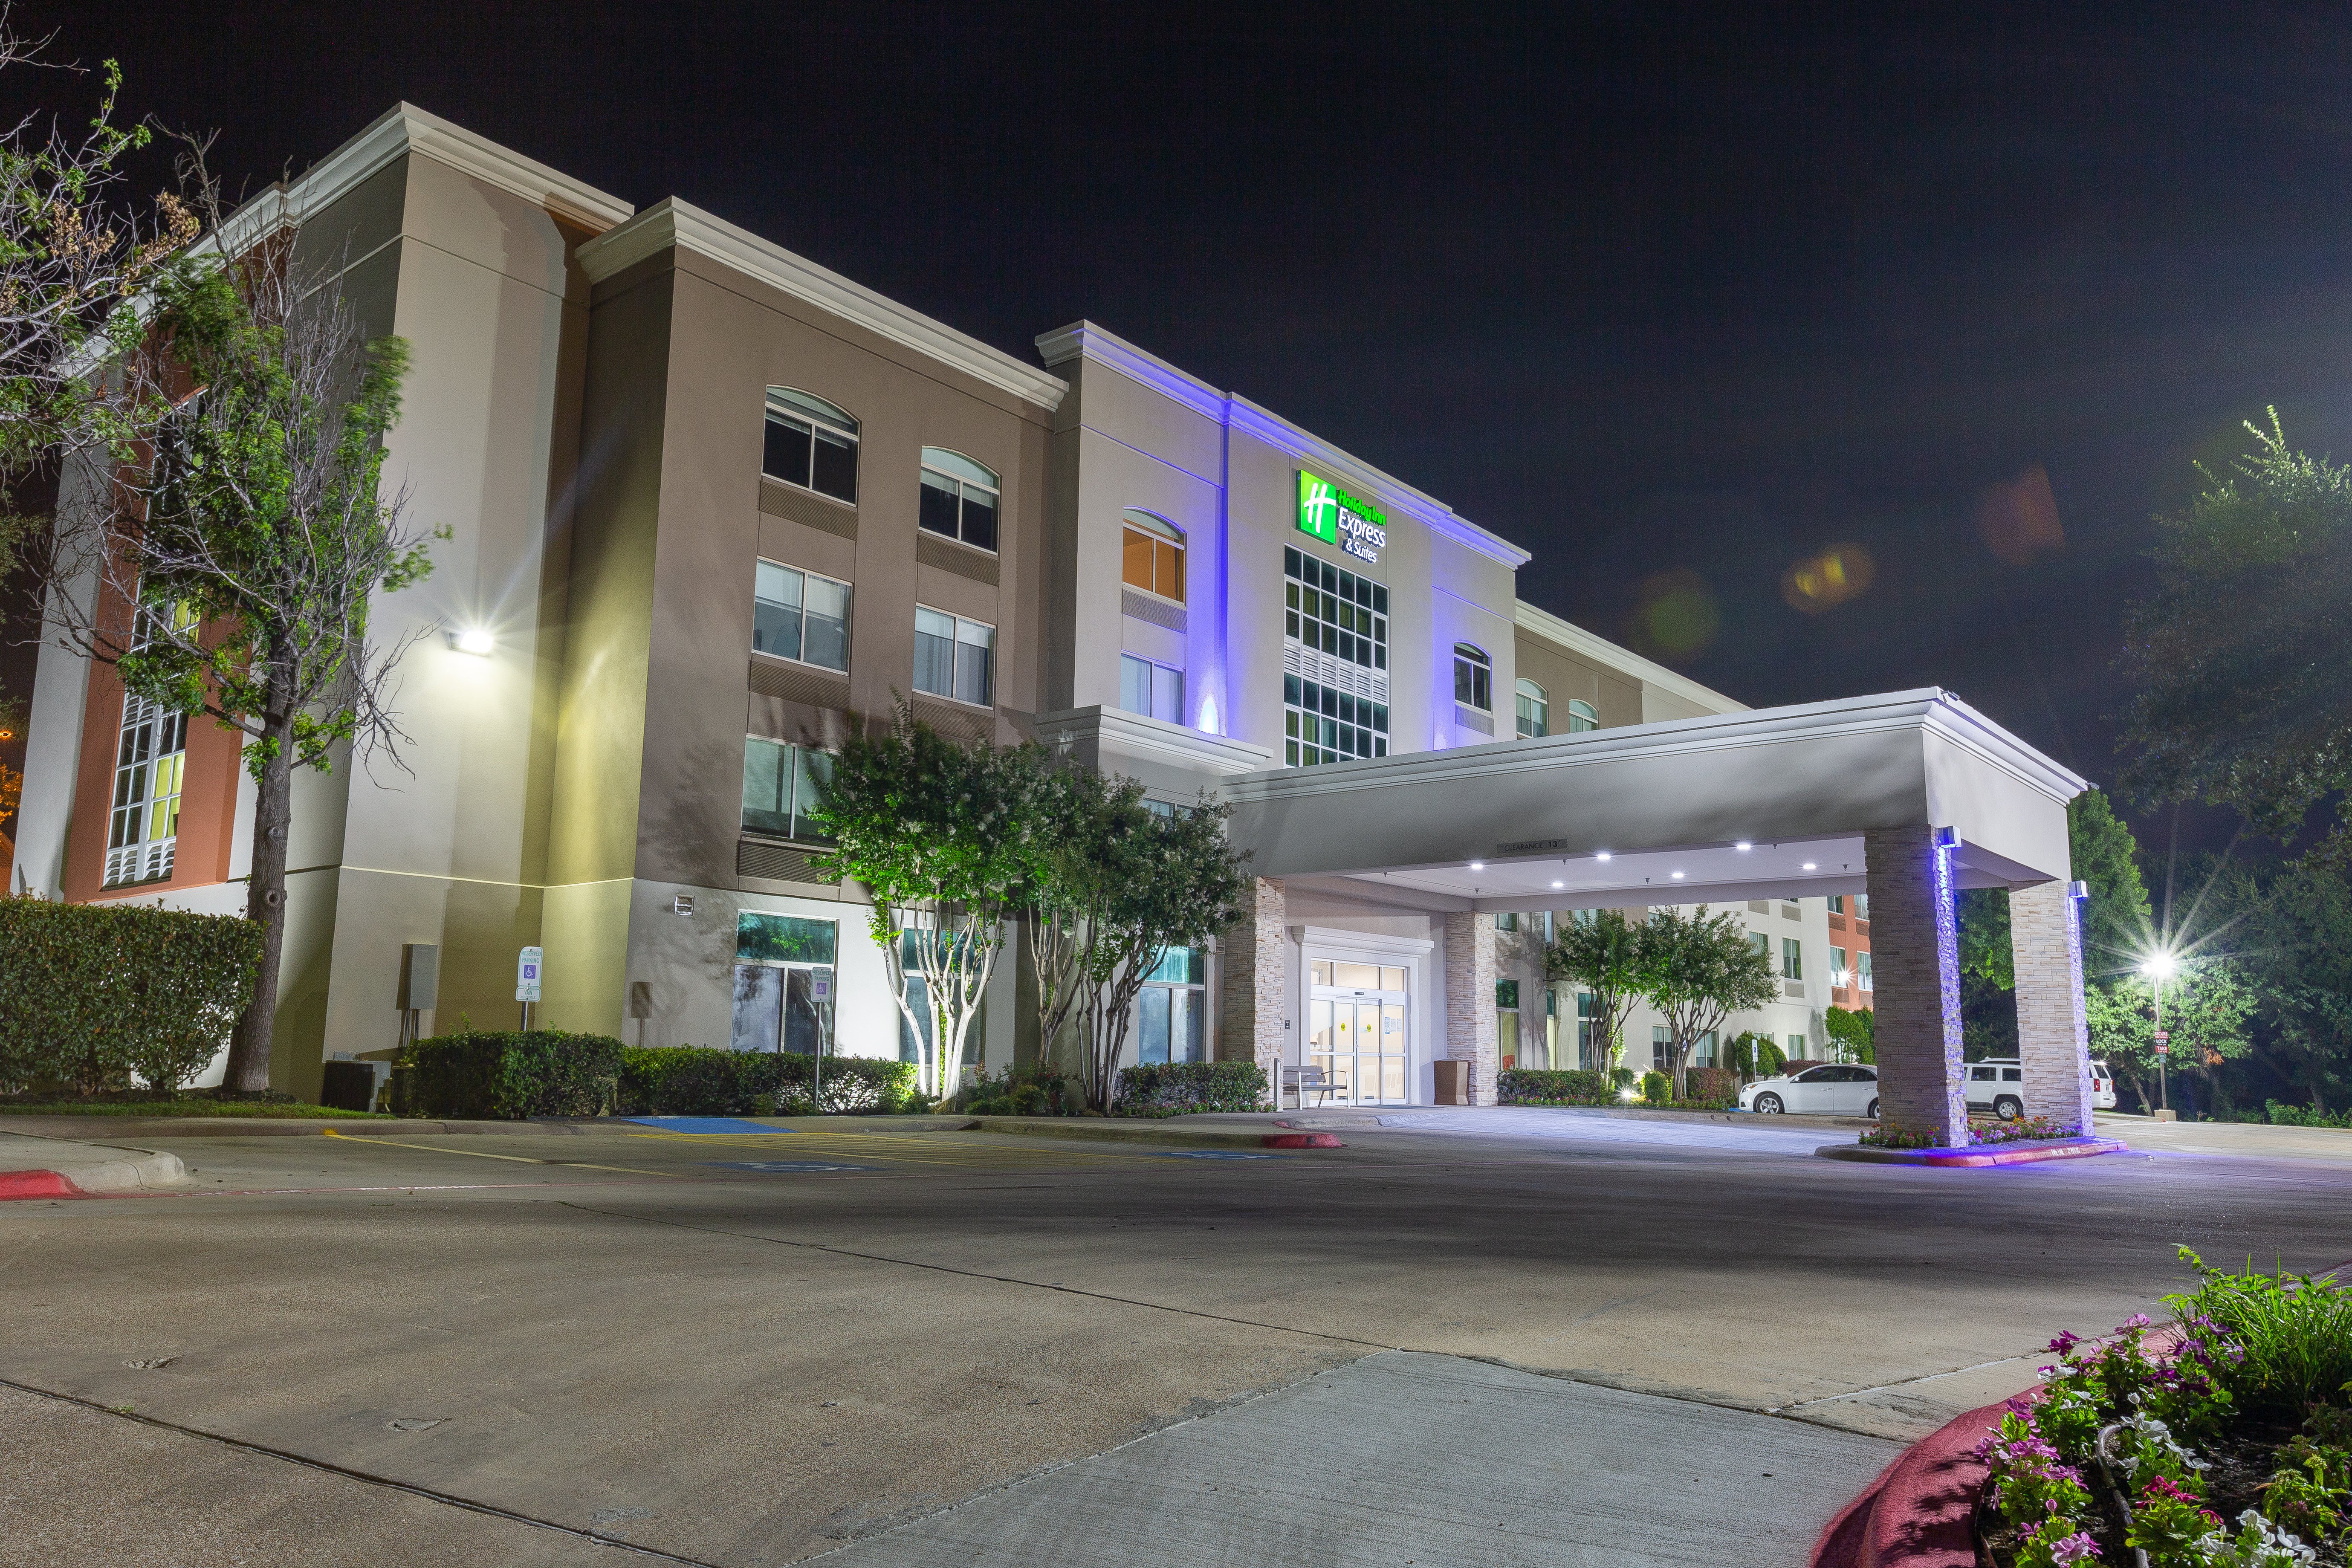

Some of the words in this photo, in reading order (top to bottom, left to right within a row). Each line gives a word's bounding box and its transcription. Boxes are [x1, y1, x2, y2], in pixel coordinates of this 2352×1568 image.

[1338, 489, 1371, 521] Holiday
[1372, 506, 1386, 526] Inn
[1338, 506, 1386, 547] Express
[1346, 538, 1353, 552] &
[1353, 541, 1377, 563] Suites
[1504, 842, 1543, 851] CLEARANCE
